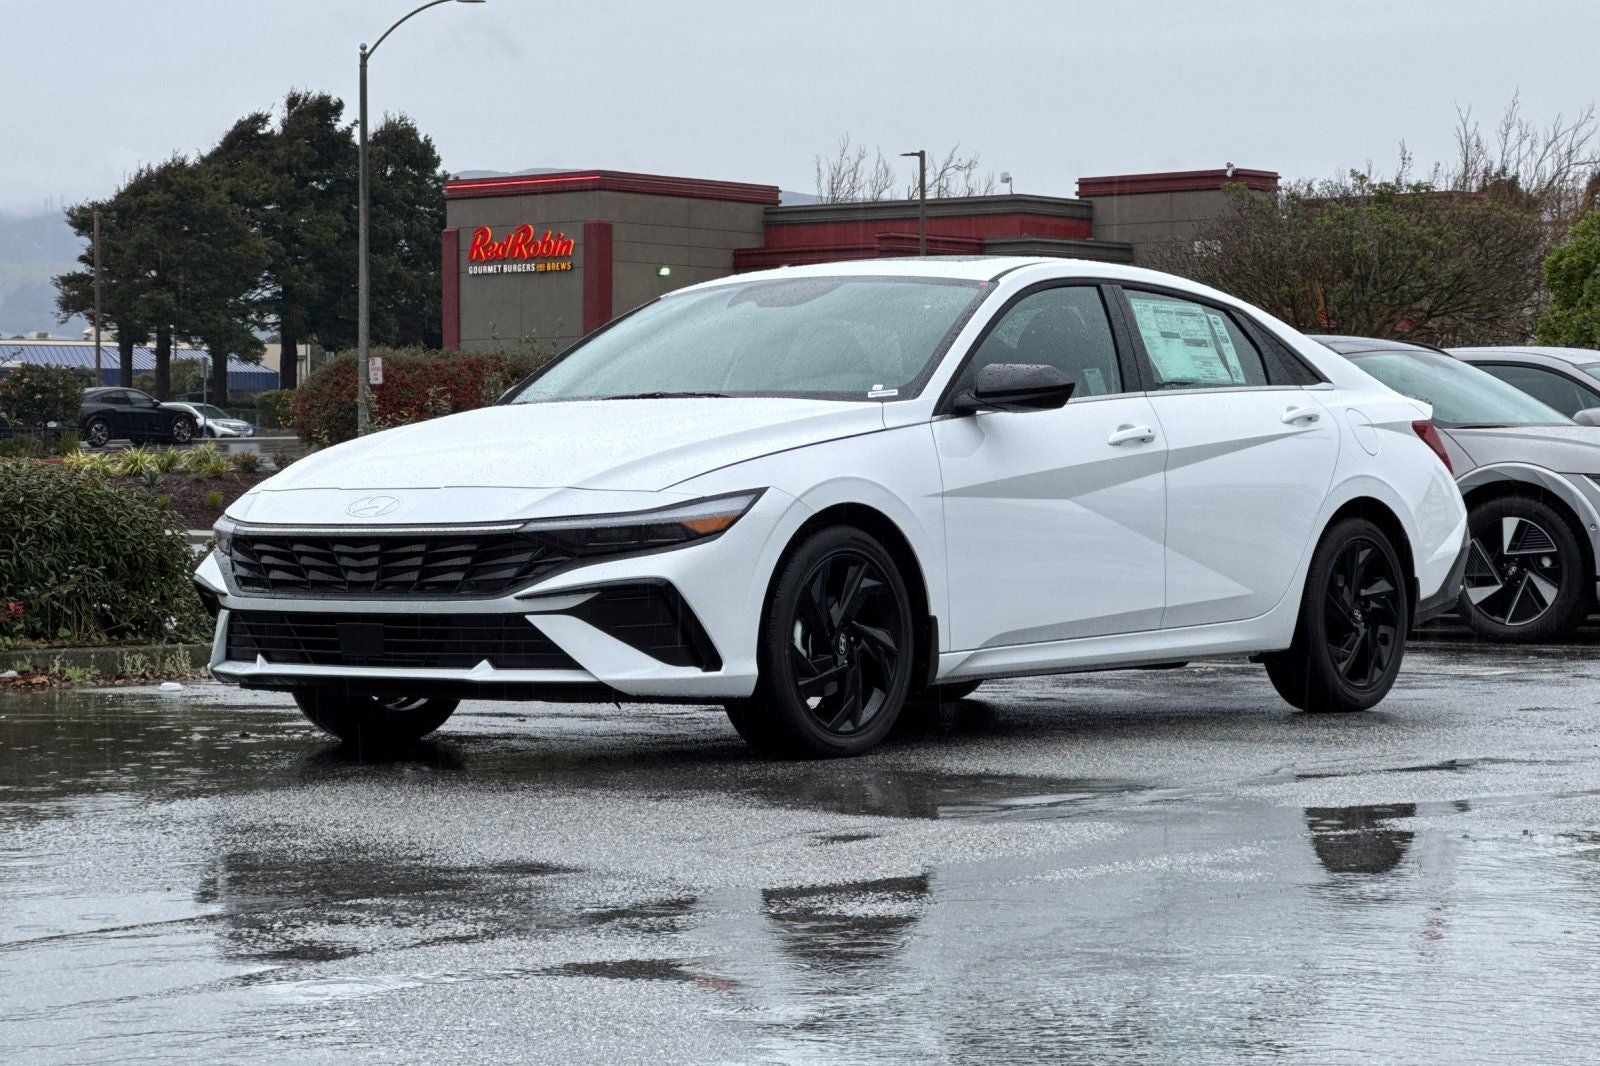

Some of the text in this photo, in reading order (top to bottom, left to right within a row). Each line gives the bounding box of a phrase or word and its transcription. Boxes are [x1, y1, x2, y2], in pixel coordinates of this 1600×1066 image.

[468, 224, 574, 262] Red Robin
[468, 264, 502, 275] GOURMET
[503, 263, 535, 273] BURGERS
[546, 262, 571, 271] BREWS
